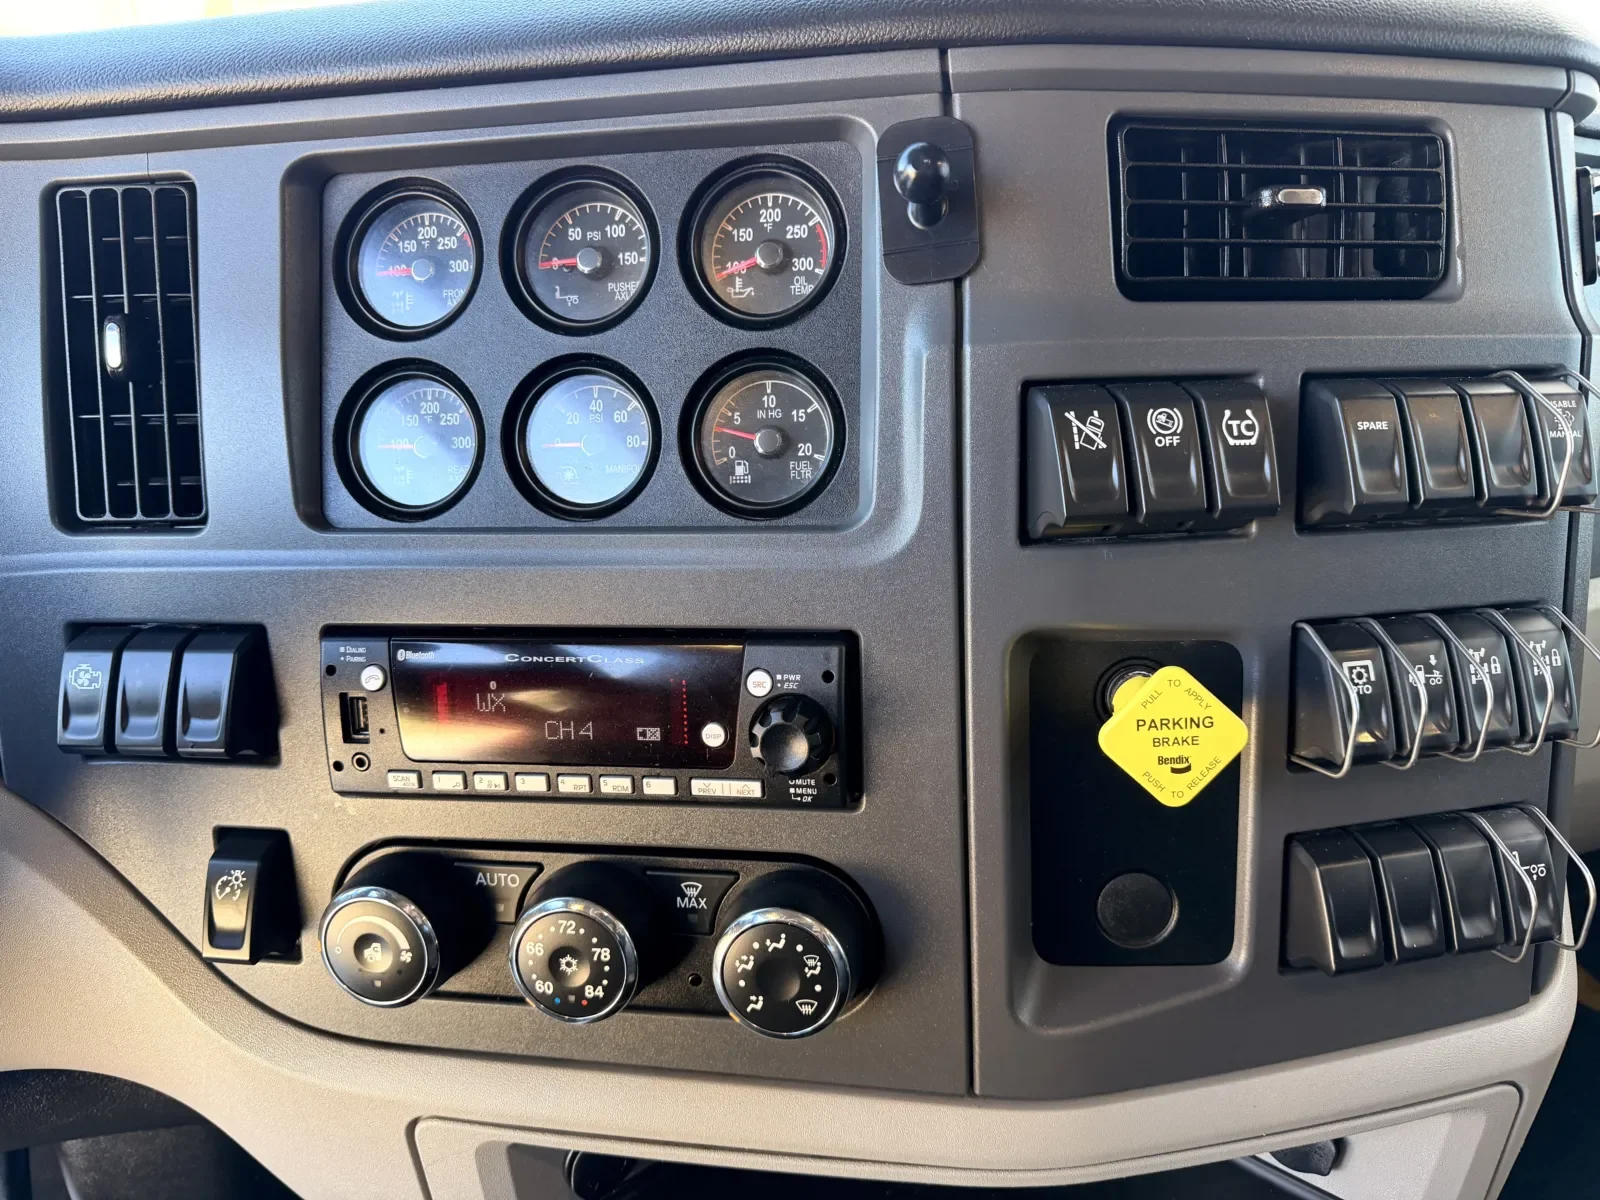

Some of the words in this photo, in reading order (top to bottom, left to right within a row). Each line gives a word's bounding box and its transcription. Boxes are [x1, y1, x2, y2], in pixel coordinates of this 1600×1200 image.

[759, 208, 781, 222] 200
[417, 227, 437, 239] 200
[568, 228, 581, 241] 50
[587, 232, 602, 241] PSI
[605, 224, 625, 238] 100
[732, 228, 753, 241] 150
[786, 225, 808, 238] 250
[398, 240, 417, 252] 150
[438, 237, 457, 250] 250
[618, 252, 638, 265] 150
[792, 258, 813, 271] 300
[449, 260, 469, 272] 300
[794, 276, 807, 285] OIL
[443, 289, 465, 298] FRON
[589, 400, 603, 412] 40
[762, 395, 776, 408] 10
[420, 402, 439, 414] 200
[757, 410, 766, 419] IN
[769, 409, 782, 418] HG
[401, 415, 418, 426] 150
[440, 414, 459, 425] 250
[566, 412, 579, 424] 20
[590, 414, 604, 423] PSI
[614, 411, 627, 423] 60
[734, 412, 741, 425] 5
[792, 409, 806, 422] 15
[1227, 420, 1253, 436] TC
[1357, 421, 1388, 431] SPARE
[452, 437, 471, 448] 300
[626, 435, 640, 447] 80
[1154, 436, 1180, 447] OFF
[729, 446, 735, 459] 0
[798, 443, 812, 456] 20
[790, 461, 812, 470] FUEL
[790, 470, 812, 479] FLTR
[406, 651, 434, 660] Bluetooth
[1141, 690, 1163, 709] PULL
[1168, 679, 1181, 688] TO
[1184, 688, 1212, 710] APPLY
[476, 693, 506, 712] WX
[1136, 716, 1214, 731] PARKING
[1152, 736, 1200, 748] BRAKE
[1158, 755, 1190, 765] Bendix
[1142, 771, 1166, 792] PUSH
[1186, 756, 1222, 791] RELEASE
[475, 872, 520, 887] AUTO
[676, 897, 707, 909] MAX
[558, 920, 576, 934] 72
[526, 942, 544, 956] 66
[592, 948, 610, 962] 78
[535, 980, 553, 995] 60
[584, 985, 604, 999] 84
